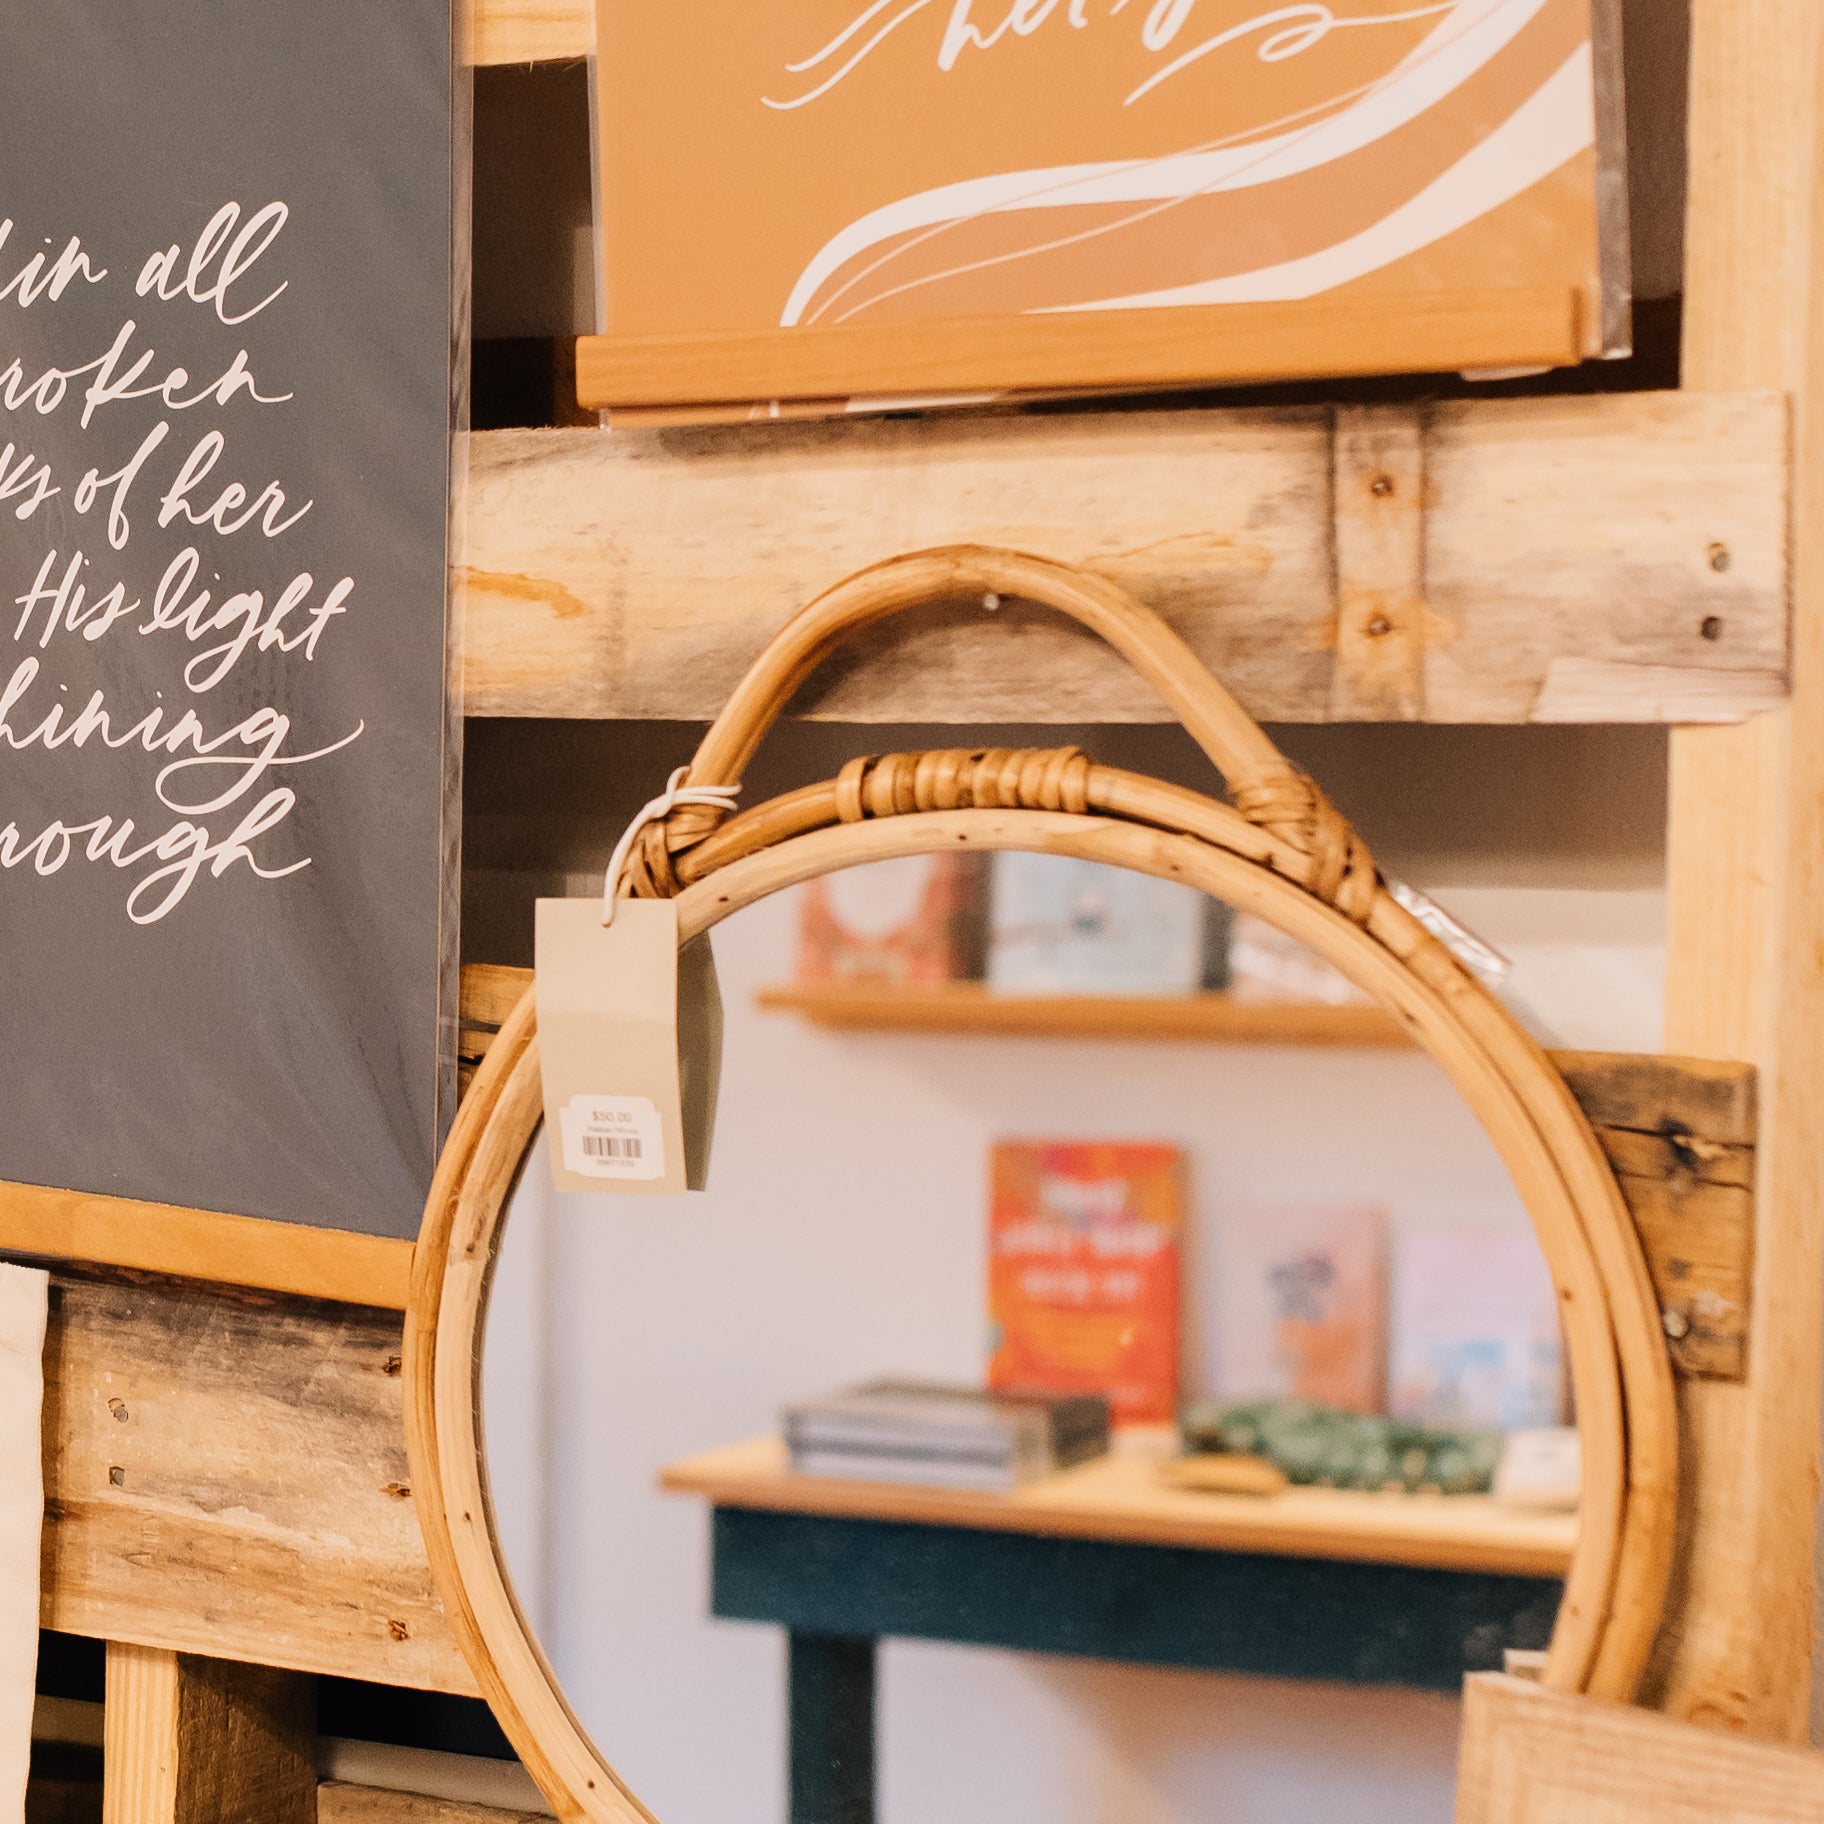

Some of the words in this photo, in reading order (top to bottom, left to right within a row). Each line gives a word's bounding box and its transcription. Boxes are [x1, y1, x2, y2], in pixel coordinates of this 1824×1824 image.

[135, 200, 289, 326] all
[73, 420, 170, 550] of
[157, 430, 314, 537] her
[13, 549, 142, 649] His
[137, 546, 356, 694] light
